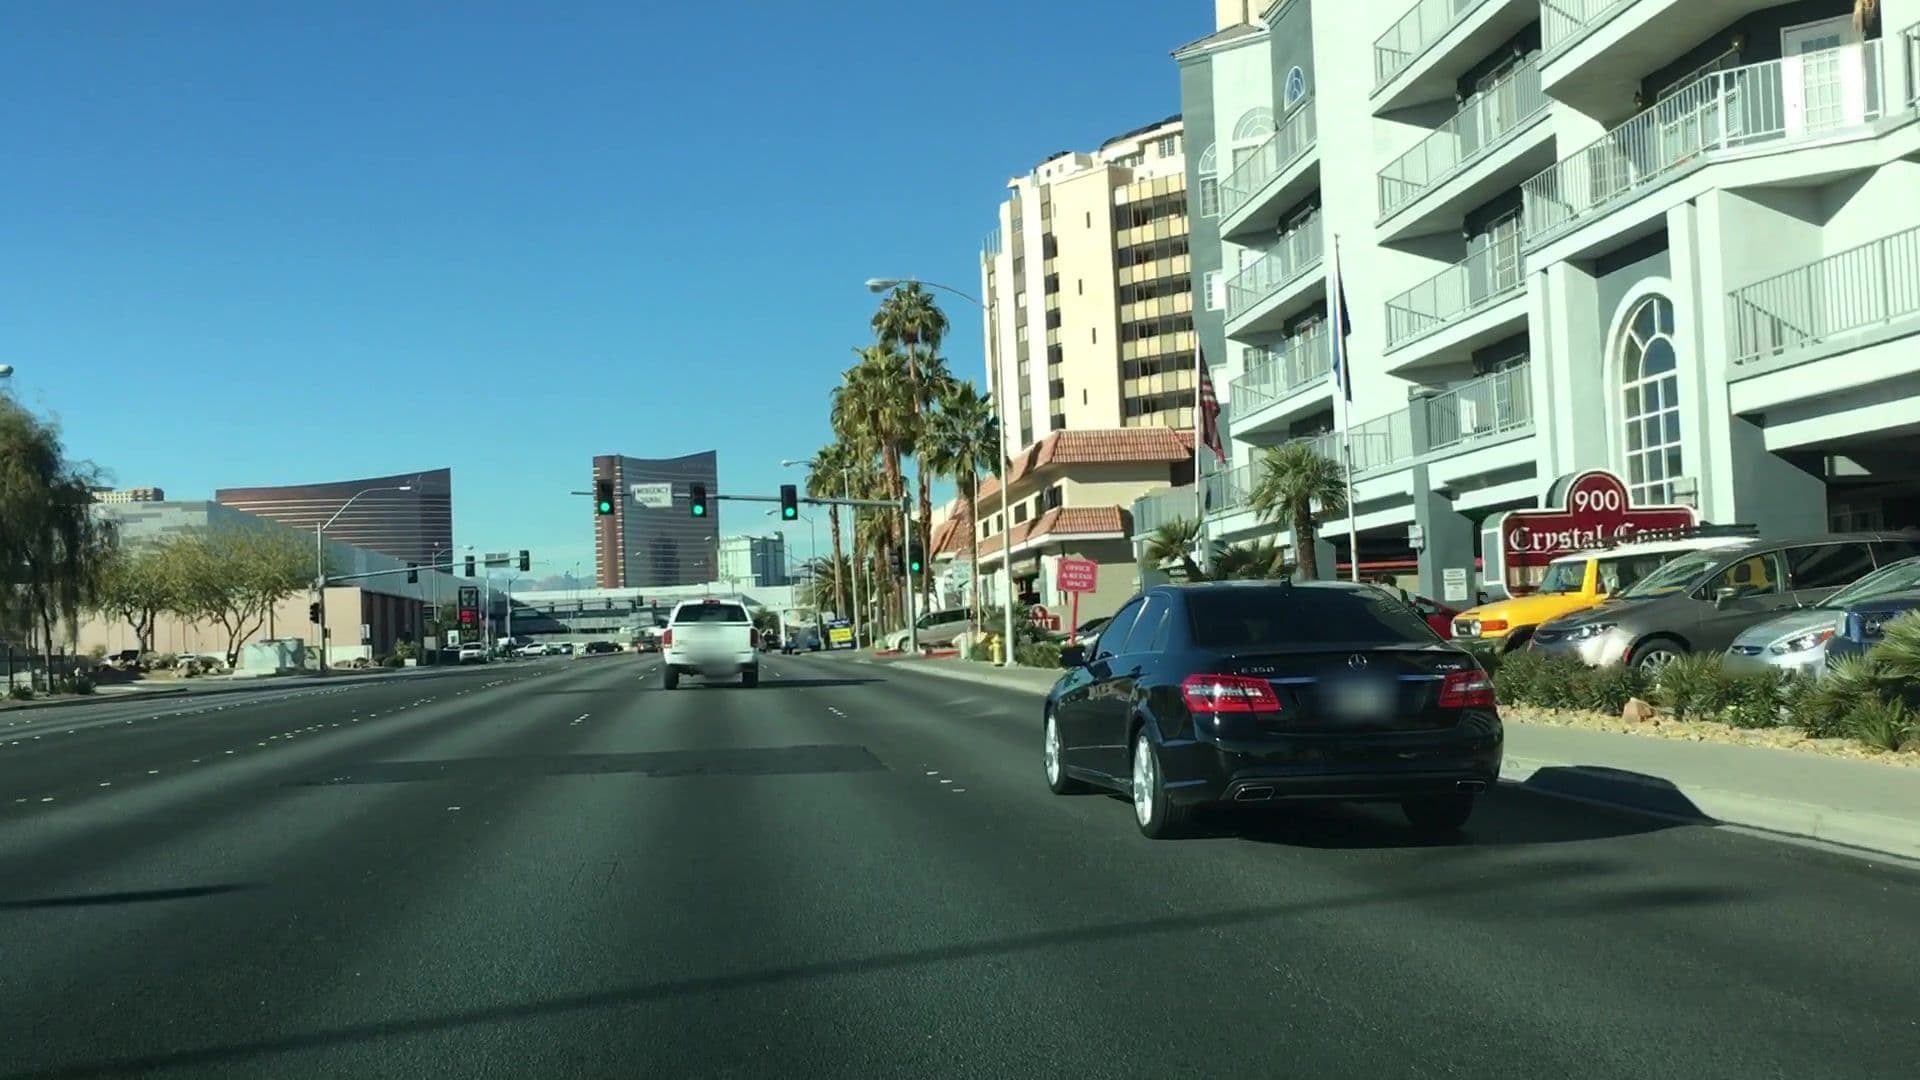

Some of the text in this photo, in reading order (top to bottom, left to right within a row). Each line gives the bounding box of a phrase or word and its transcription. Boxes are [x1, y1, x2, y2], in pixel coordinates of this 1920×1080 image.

[1575, 489, 1619, 512] 900
[1509, 524, 1604, 554] Crystal
[1069, 572, 1093, 580] RETAIL
[1066, 580, 1088, 588] SPACE
[1026, 618, 1054, 630] XIT
